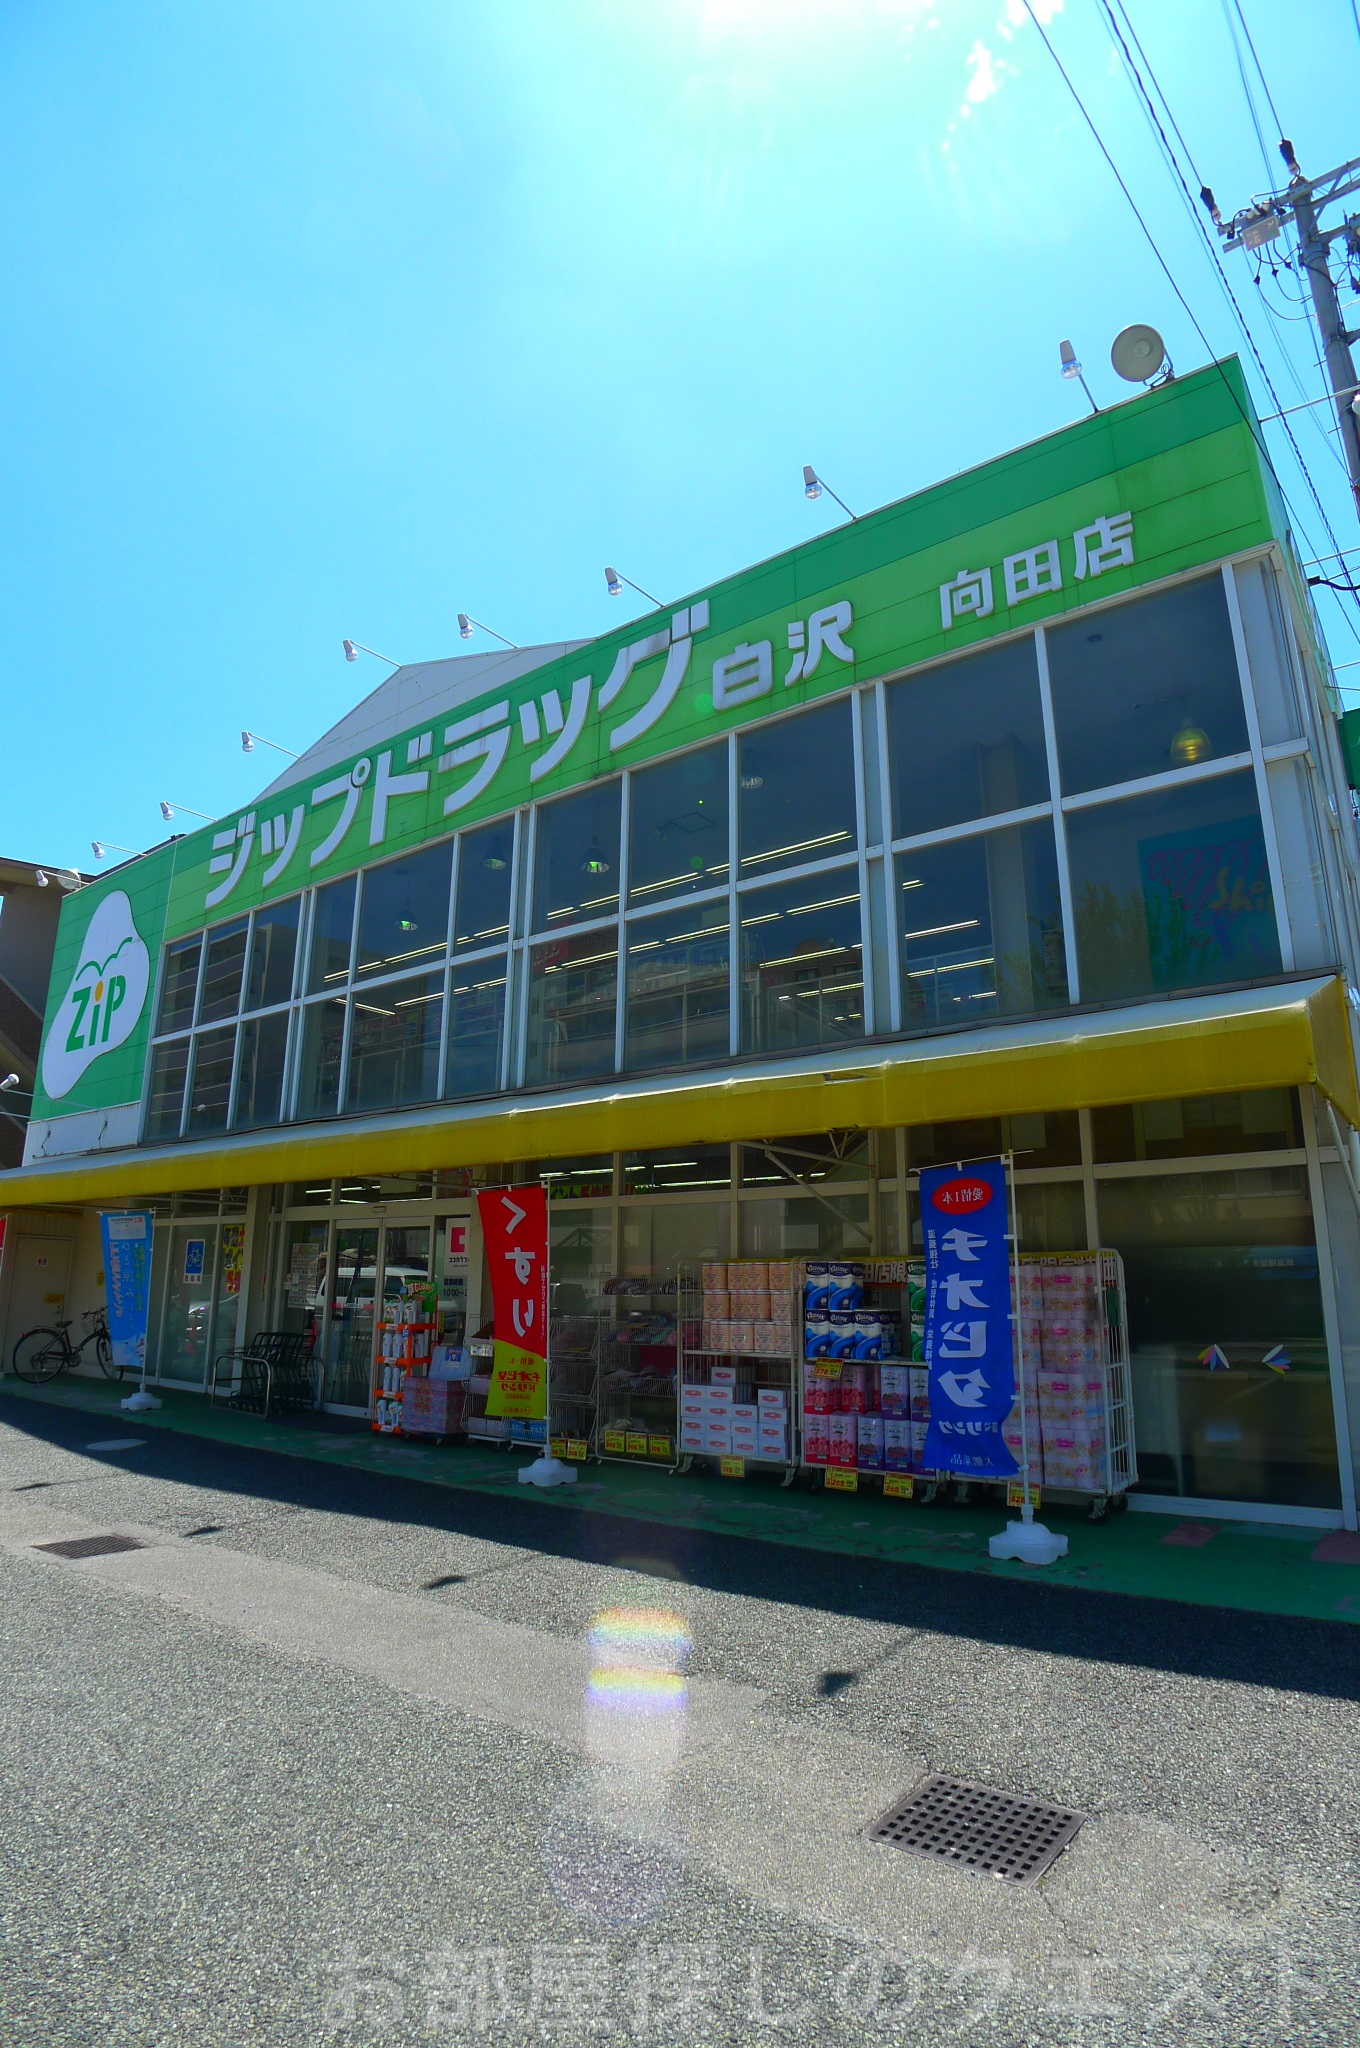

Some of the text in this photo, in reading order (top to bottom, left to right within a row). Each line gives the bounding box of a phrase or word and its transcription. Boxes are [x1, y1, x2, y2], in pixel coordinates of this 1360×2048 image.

[205, 510, 1135, 910] ジップドラッグ 白沢 向田店
